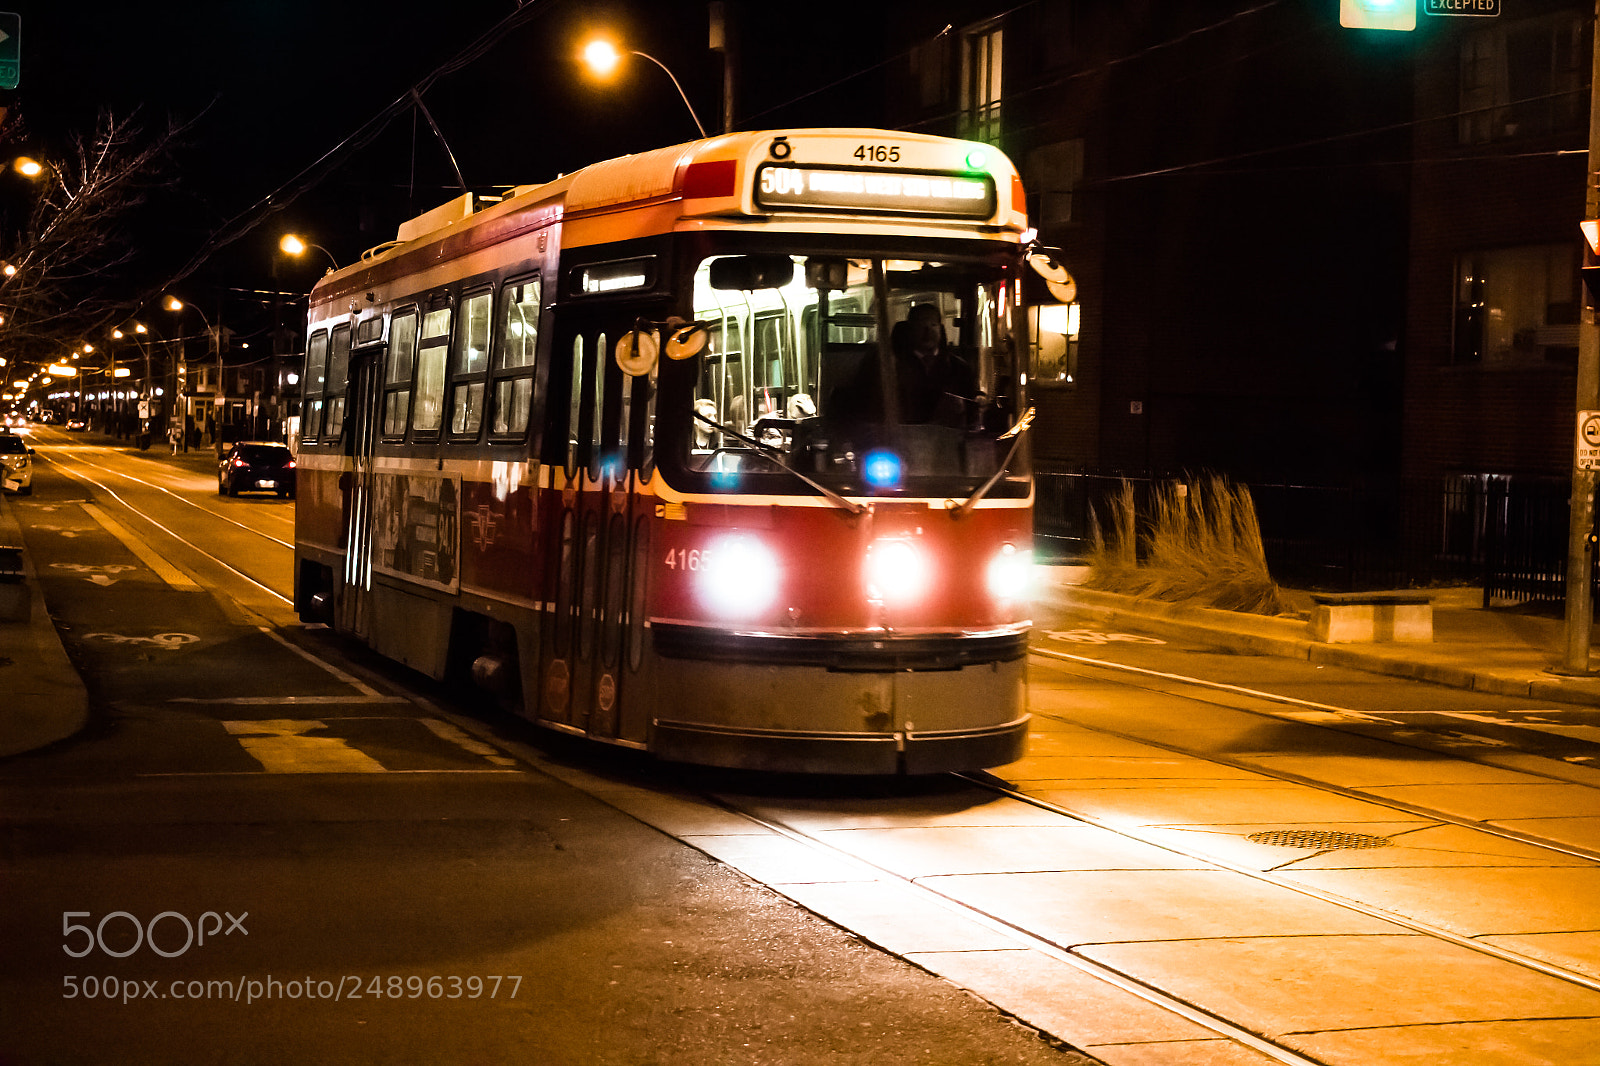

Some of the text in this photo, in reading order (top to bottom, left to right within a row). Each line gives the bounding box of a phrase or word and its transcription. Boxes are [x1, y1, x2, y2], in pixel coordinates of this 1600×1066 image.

[1431, 0, 1494, 10] EXCEPTED
[853, 145, 900, 163] 4165
[761, 167, 804, 195] 504
